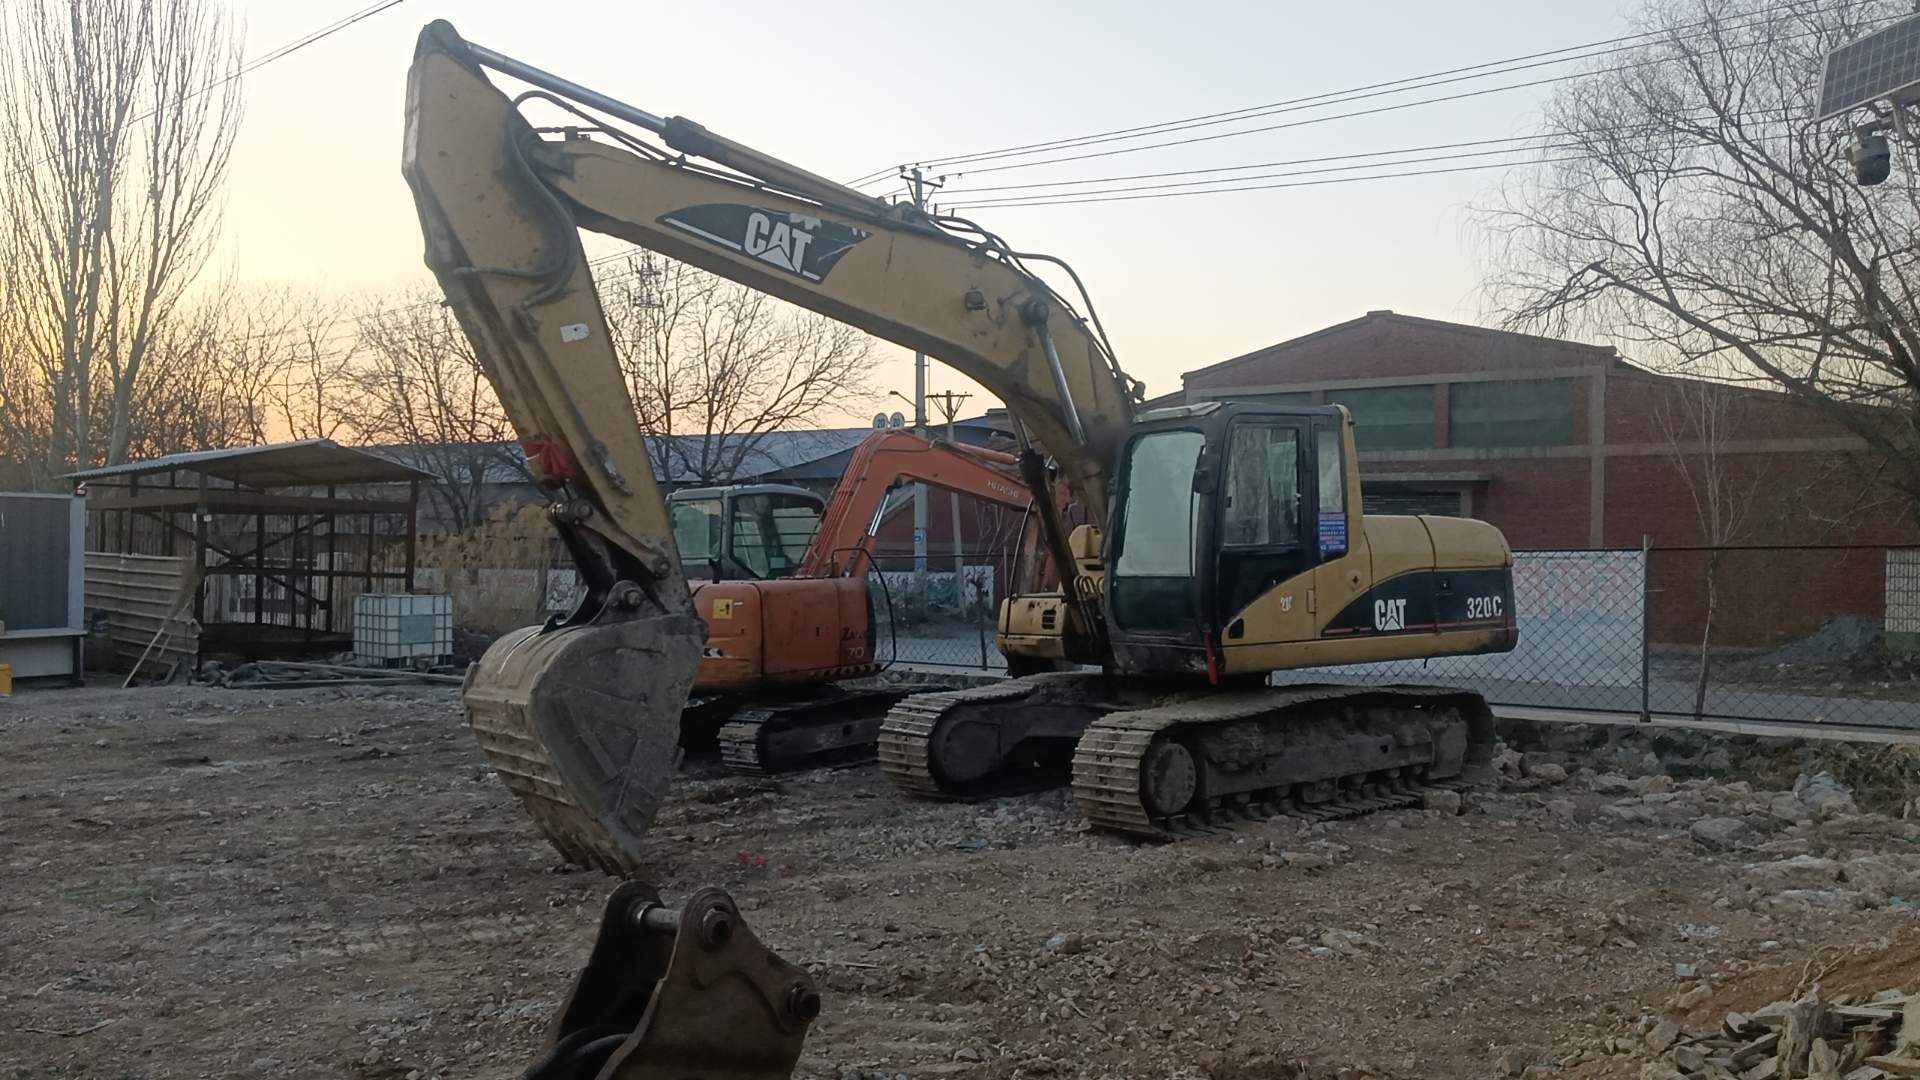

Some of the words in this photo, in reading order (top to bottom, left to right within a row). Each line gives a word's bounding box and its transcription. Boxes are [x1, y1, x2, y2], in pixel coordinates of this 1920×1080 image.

[744, 212, 813, 273] CAT
[1374, 598, 1407, 631] CAT
[1467, 595, 1503, 619] 320C
[848, 646, 864, 658] 70
